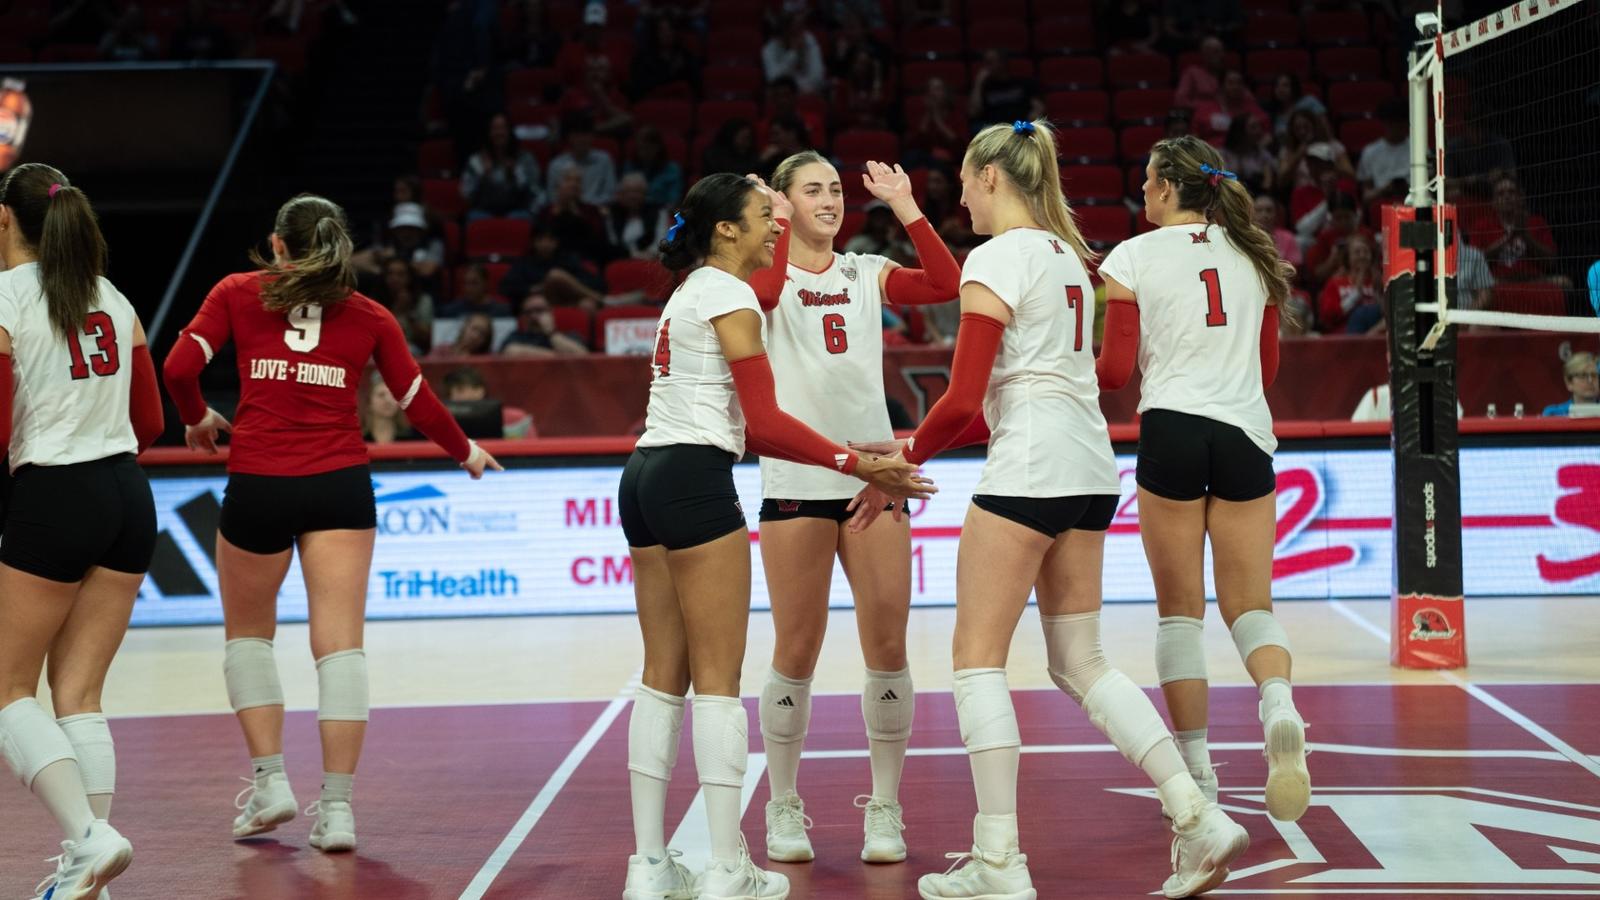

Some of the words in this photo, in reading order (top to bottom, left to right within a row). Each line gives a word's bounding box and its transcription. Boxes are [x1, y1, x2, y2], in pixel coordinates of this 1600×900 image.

[797, 288, 851, 307] Miami
[1065, 285, 1083, 352] 7
[1199, 268, 1227, 327] 1
[66, 310, 120, 380] 13
[283, 303, 324, 353] 9
[822, 313, 848, 354] 6
[565, 499, 622, 526] MI
[378, 569, 518, 599] TriHealth
